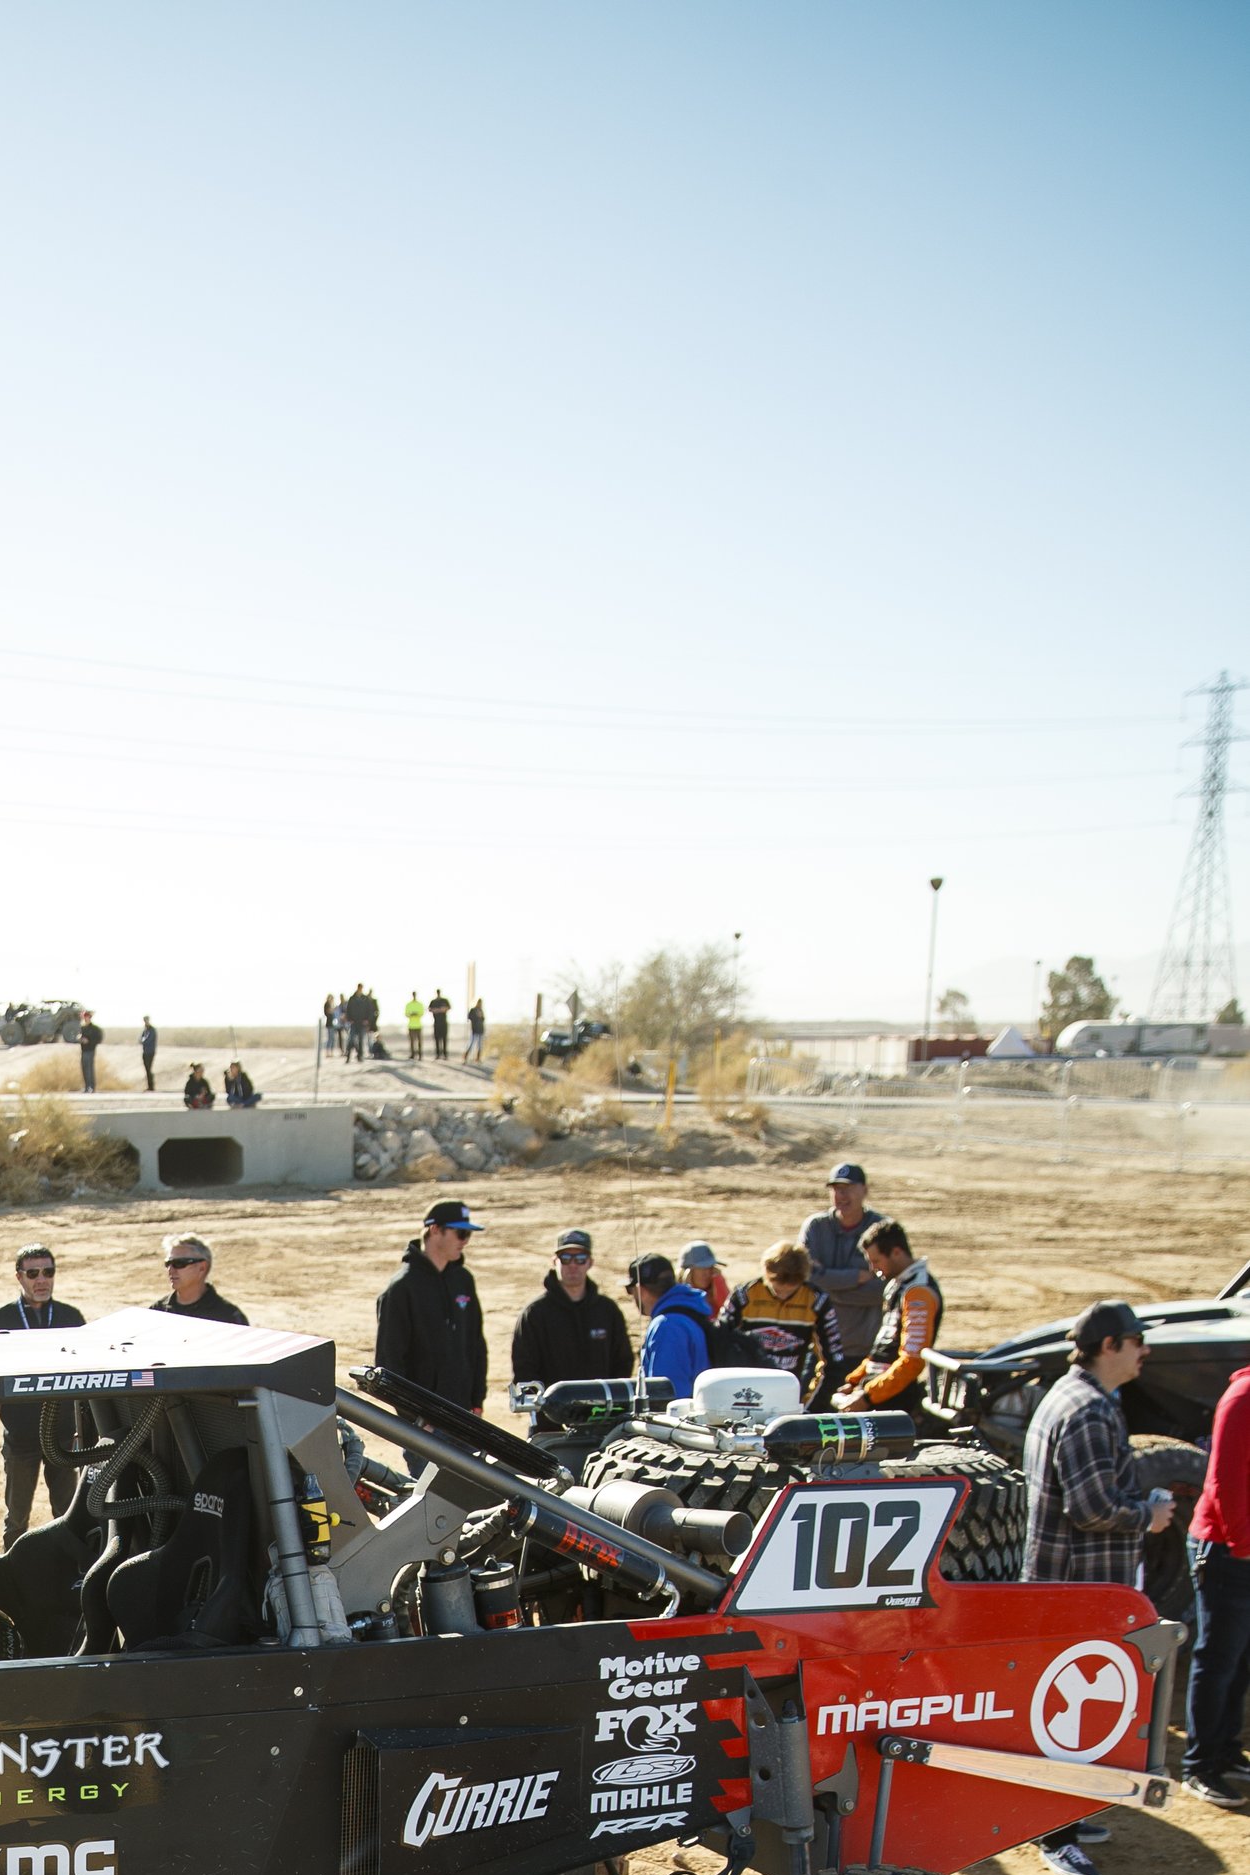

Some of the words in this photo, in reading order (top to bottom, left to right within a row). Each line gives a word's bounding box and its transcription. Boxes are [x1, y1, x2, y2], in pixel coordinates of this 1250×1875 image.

[13, 1372, 128, 1393] C.CURRIE
[790, 1500, 921, 1591] 102
[599, 1652, 700, 1680] Motive
[608, 1677, 688, 1701] Gear
[595, 1702, 698, 1752] FOX
[817, 1691, 1015, 1735] MAGPUL
[403, 1771, 560, 1848] CURRIE
[590, 1782, 693, 1814] MAHLE
[590, 1810, 689, 1840] RZR
